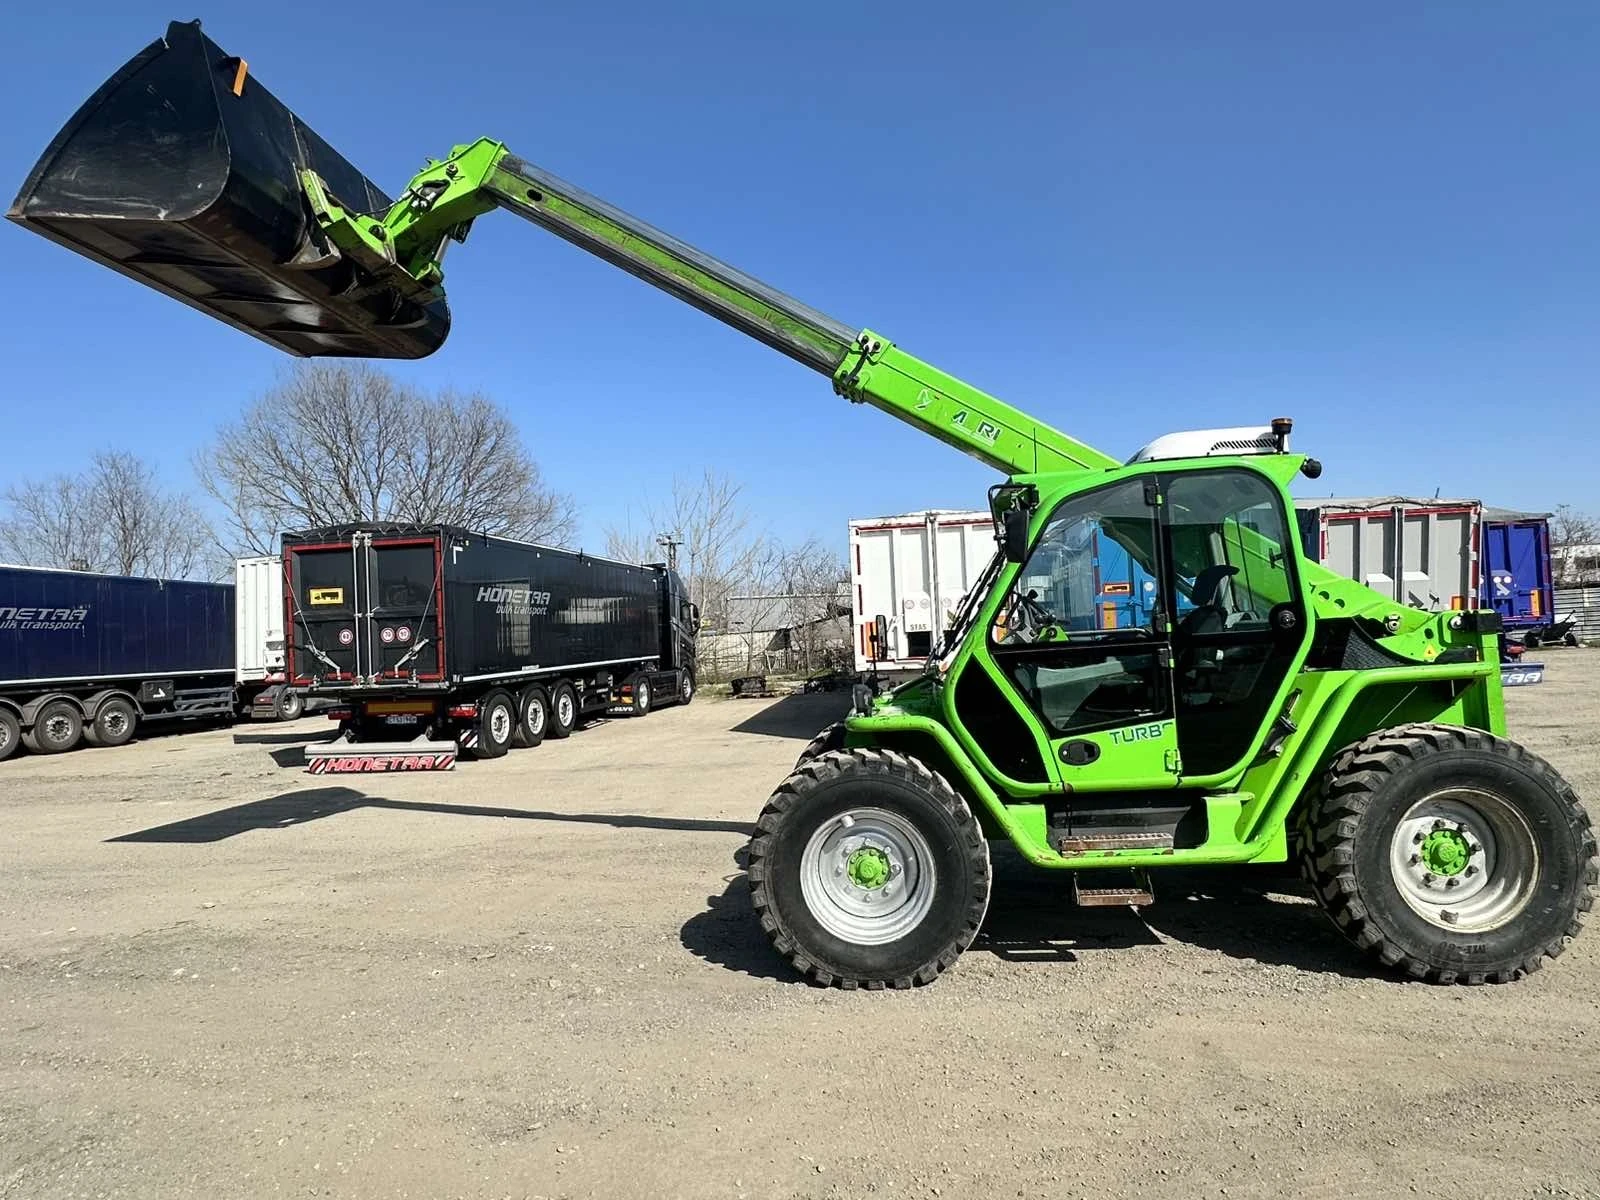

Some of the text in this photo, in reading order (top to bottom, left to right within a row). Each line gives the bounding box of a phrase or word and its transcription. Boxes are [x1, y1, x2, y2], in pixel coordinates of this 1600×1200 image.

[495, 604, 548, 616] bulk transport
[20, 621, 82, 631] transport
